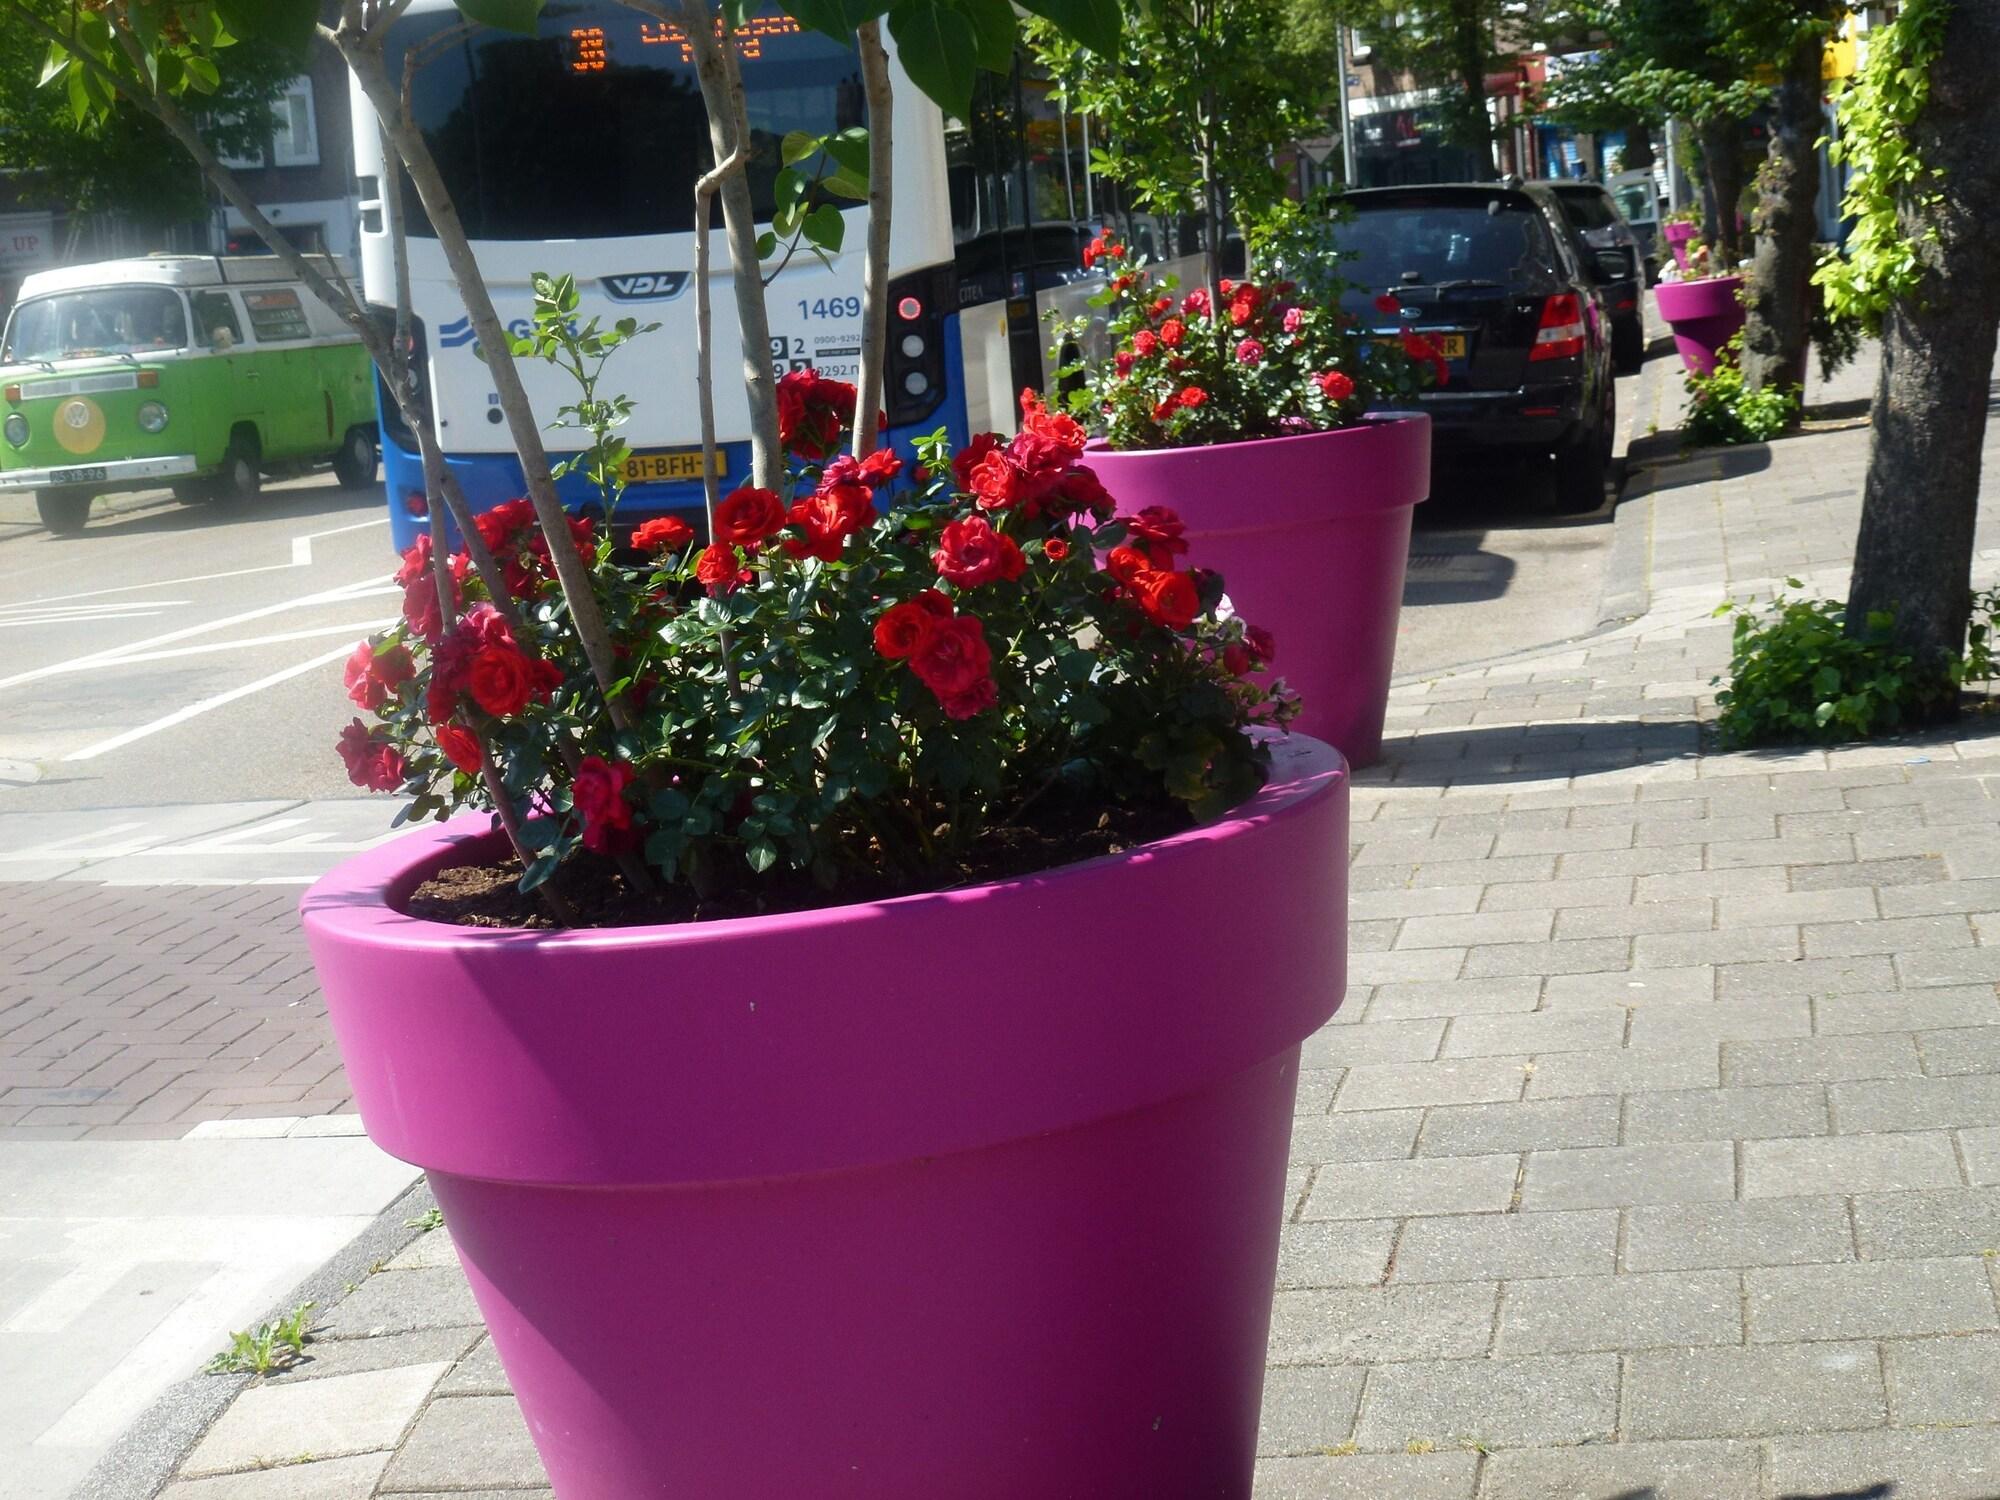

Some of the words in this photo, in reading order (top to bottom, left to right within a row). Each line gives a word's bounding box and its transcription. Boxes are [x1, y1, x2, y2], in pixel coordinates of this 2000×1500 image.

[612, 276, 675, 295] VDL
[798, 297, 860, 320] 1469
[814, 334, 860, 344] 0900-9292
[626, 455, 704, 478] 81-BFH-
